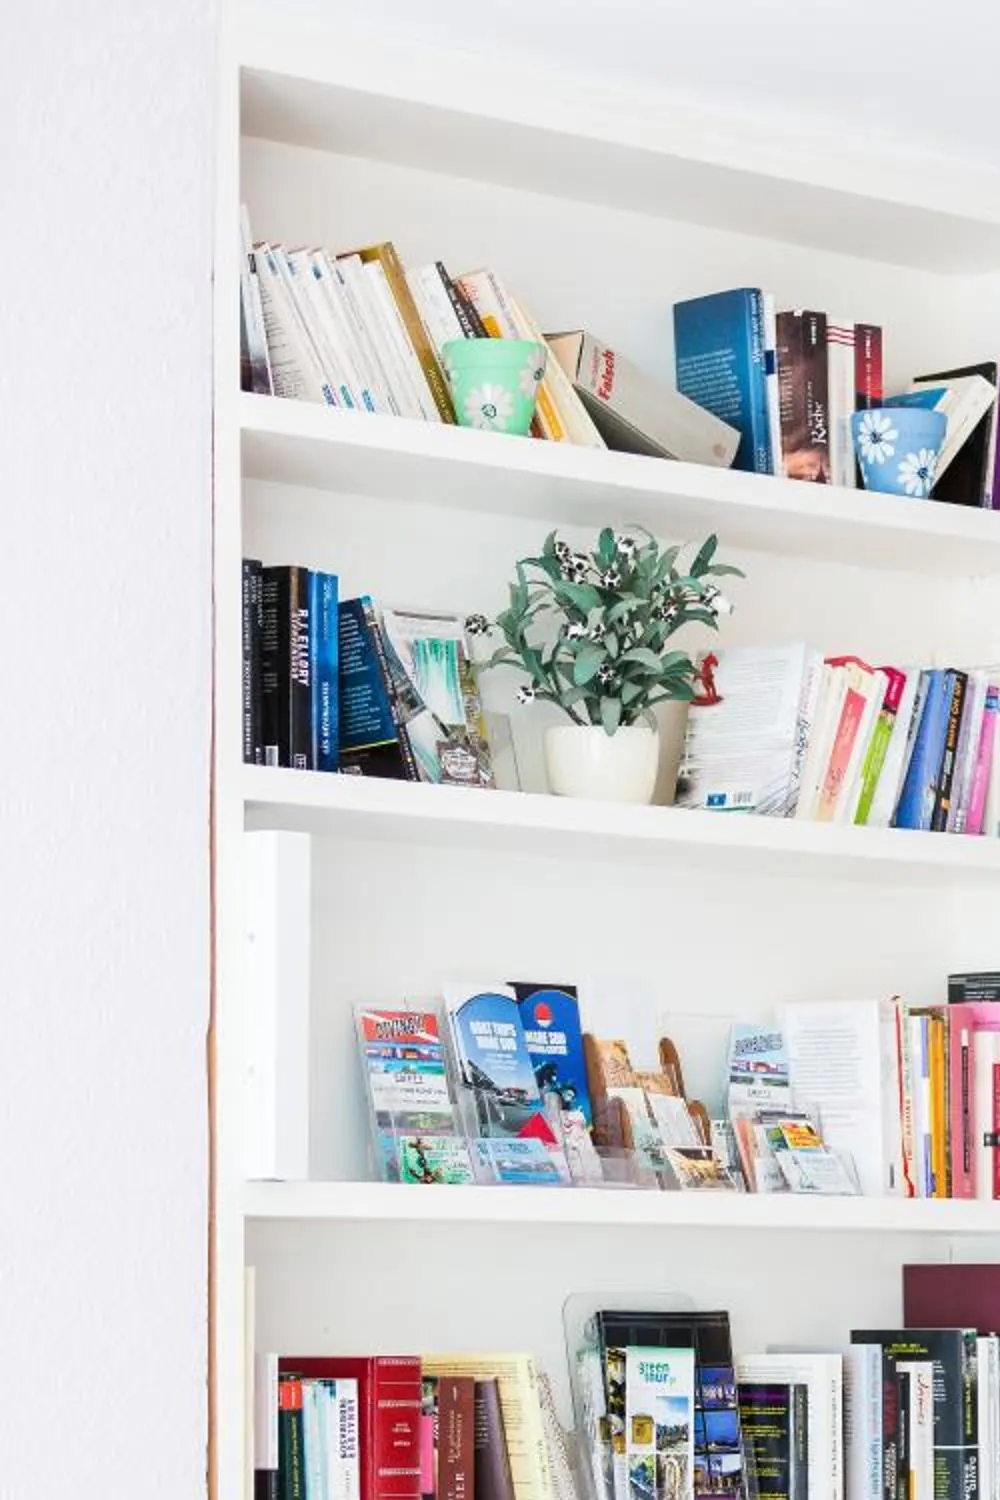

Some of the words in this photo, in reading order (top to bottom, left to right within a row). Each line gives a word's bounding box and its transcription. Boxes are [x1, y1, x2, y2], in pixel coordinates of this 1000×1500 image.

[597, 349, 615, 401] Falsch
[811, 401, 828, 445] Rache
[296, 635, 310, 687] ELLORY
[969, 1455, 977, 1491] DAVID
